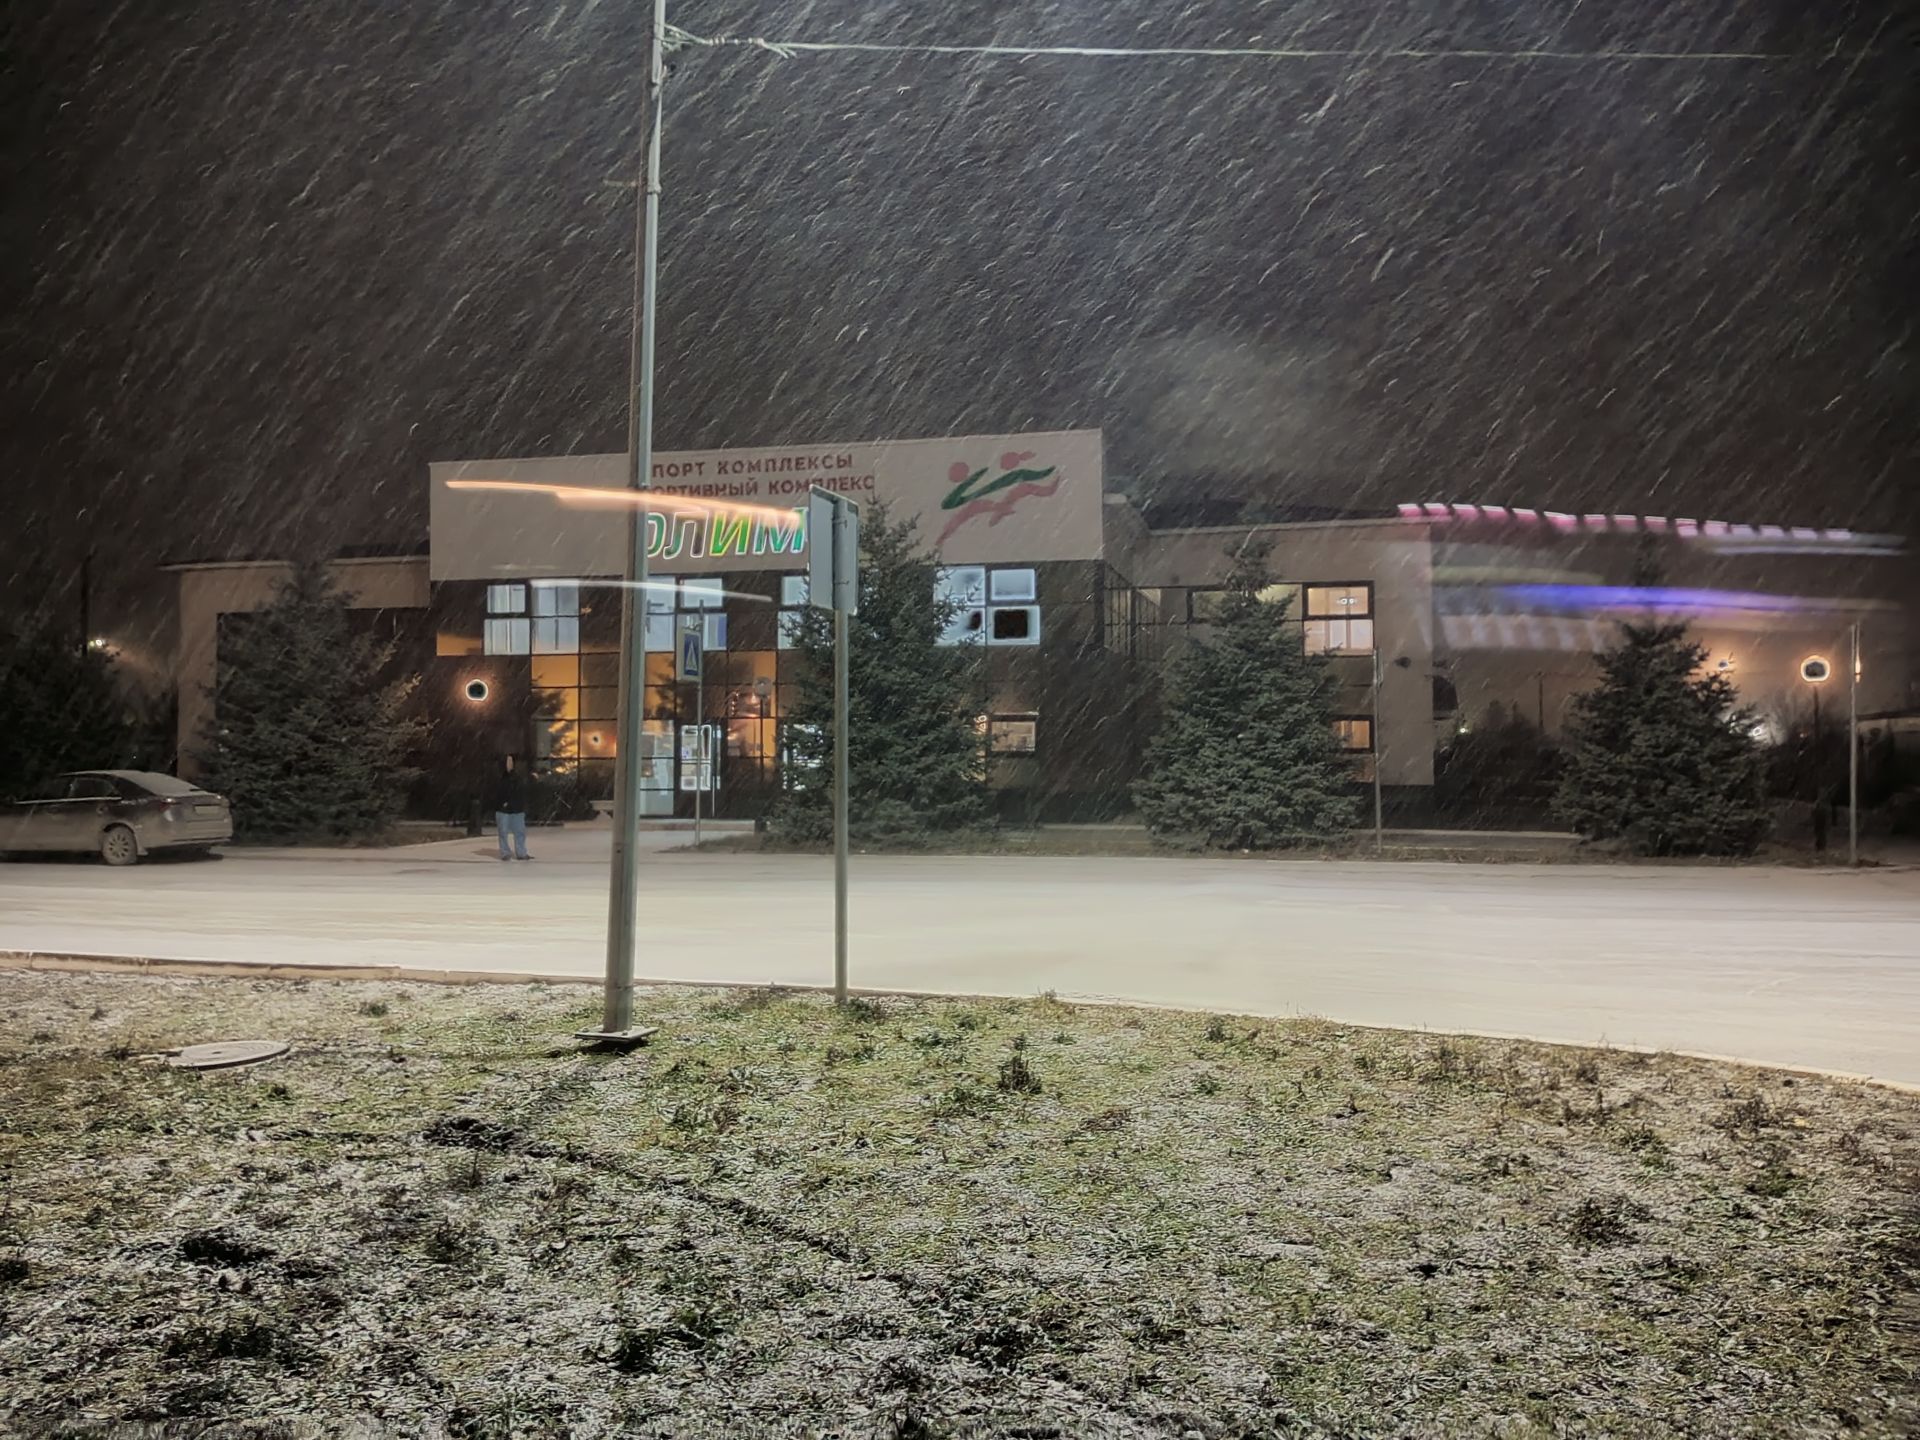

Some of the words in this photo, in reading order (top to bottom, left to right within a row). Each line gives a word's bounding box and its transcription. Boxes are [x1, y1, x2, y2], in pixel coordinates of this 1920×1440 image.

[652, 461, 706, 478] ПОРТ
[717, 454, 853, 475] КОМПЛЕКСЫ
[651, 476, 759, 497] ОРТИВНЫЙ
[647, 507, 808, 559] ОЛИМ
